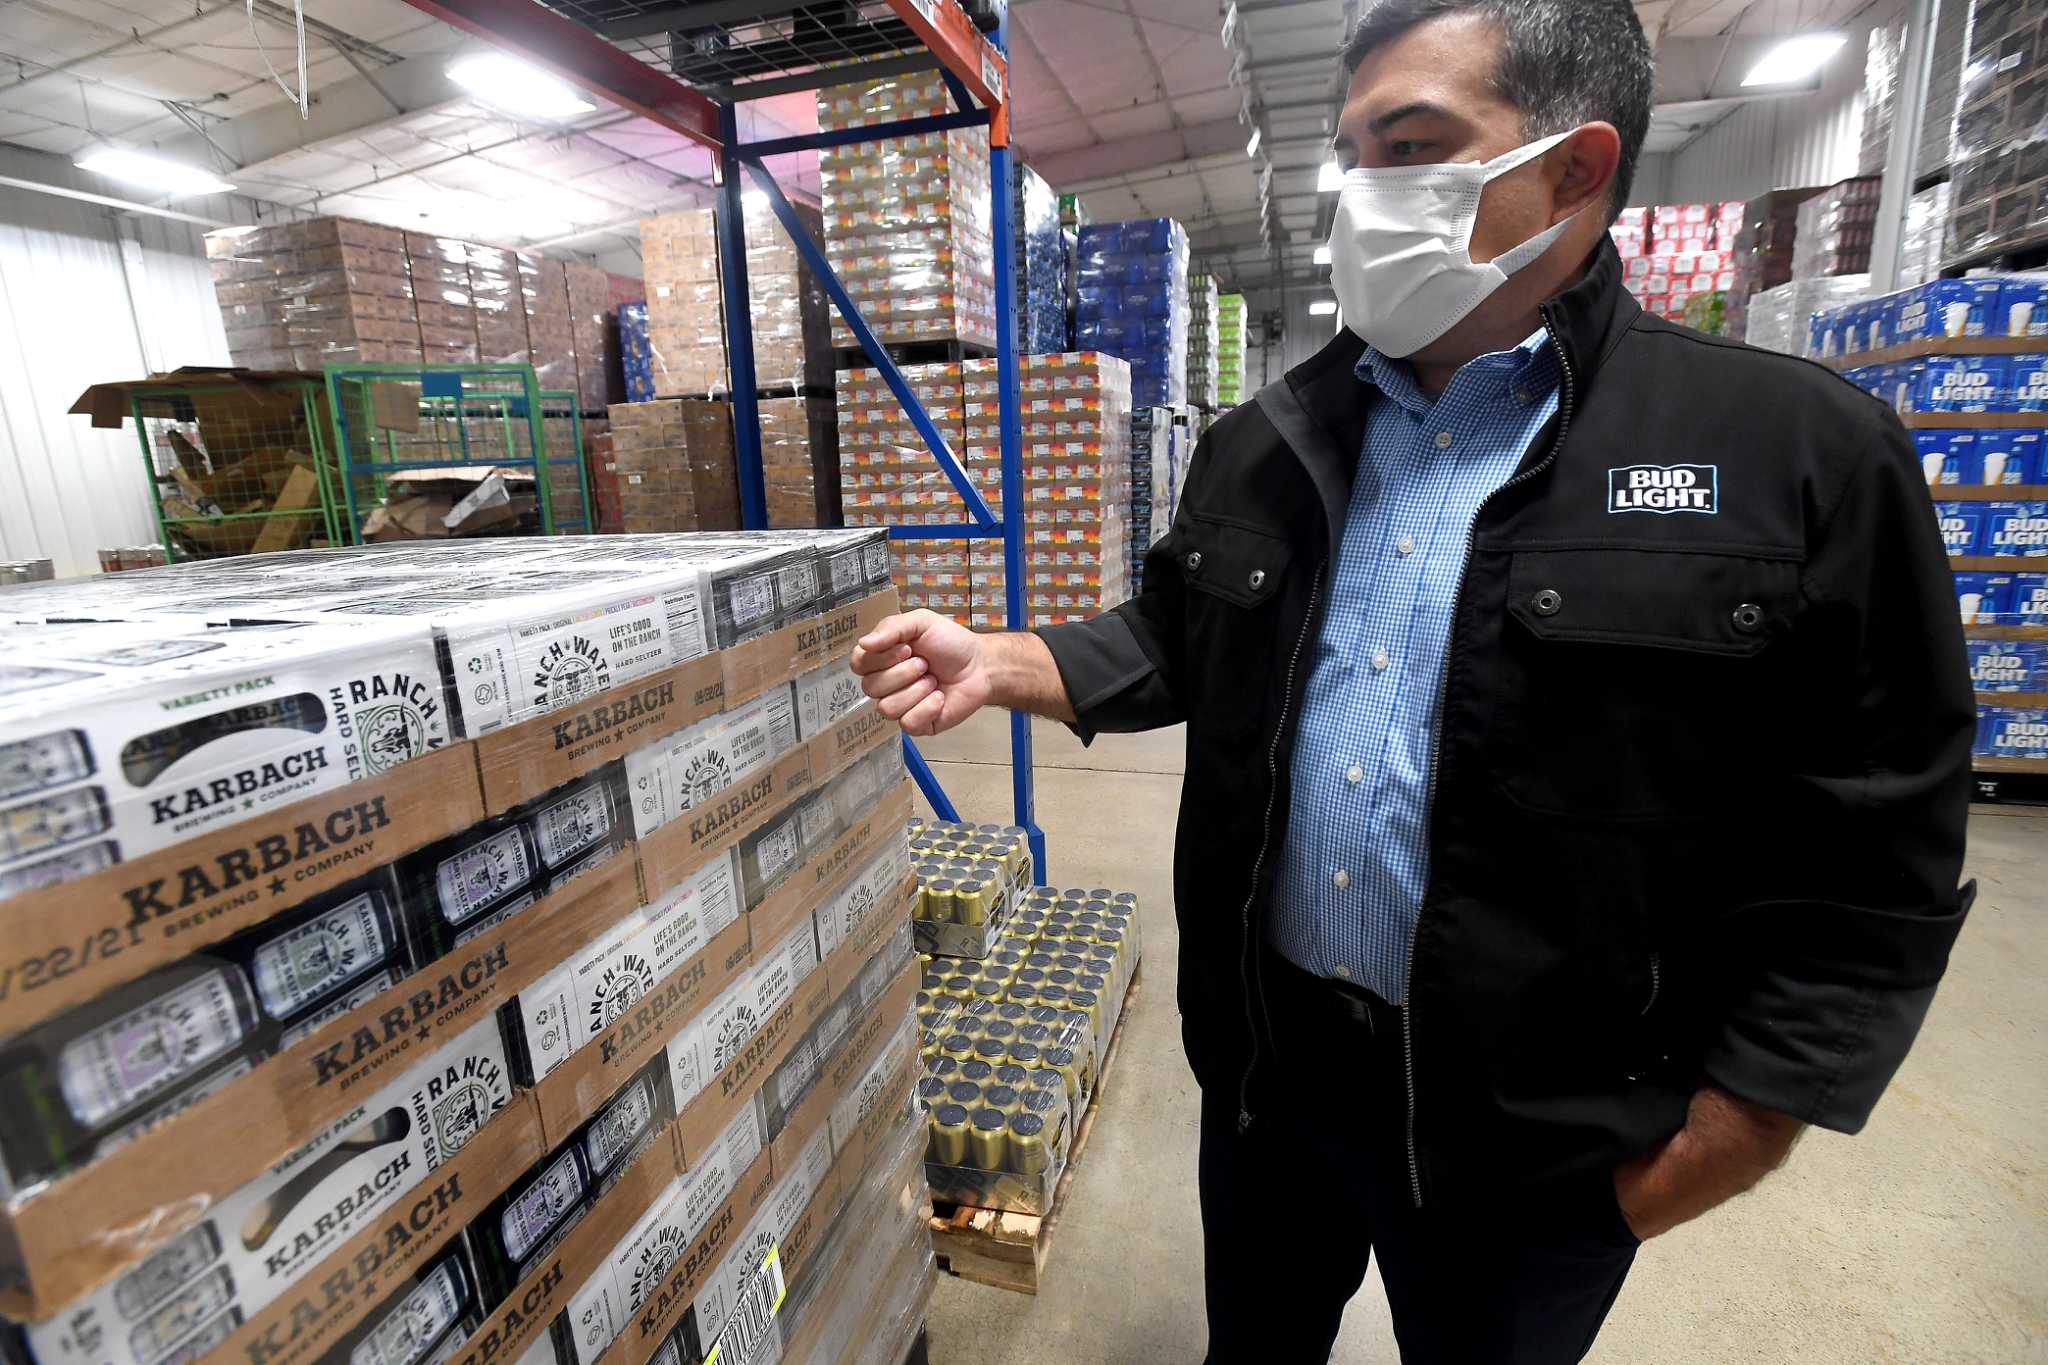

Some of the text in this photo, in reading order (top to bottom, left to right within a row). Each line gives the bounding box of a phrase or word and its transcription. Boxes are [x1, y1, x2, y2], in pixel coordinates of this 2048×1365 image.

[1932, 386, 1996, 401] LIGHT
[1942, 372, 1989, 387] BUD
[2017, 386, 2048, 401] LIG
[1615, 488, 1711, 509] LIGHT
[1629, 469, 1697, 489] BUD
[1938, 518, 1966, 532] UD
[2004, 518, 2048, 532] BUD
[2019, 601, 2048, 616] LIG
[609, 622, 632, 640] LIFE'S
[612, 641, 623, 653] ON
[624, 635, 639, 650] THE
[534, 641, 564, 705] ANCH
[573, 635, 611, 691] WATE
[615, 648, 662, 670] HARD SELTZER
[1969, 668, 2028, 682] LIGHT
[1976, 655, 2022, 669] BUD
[235, 675, 275, 695] PACK
[349, 673, 437, 720] RANCH
[329, 687, 353, 738] HARD
[552, 680, 675, 750] KARBACH
[2005, 722, 2048, 737] BUD
[568, 711, 666, 762] BREWING COMPANY
[151, 746, 328, 825] KARBACH
[259, 777, 318, 802] COMPANY
[681, 756, 702, 810] ANCH
[707, 749, 732, 788] WATE
[688, 774, 773, 844] KARBACH
[122, 794, 391, 926] KARBACH
[162, 840, 376, 938] BREWING COMPANY
[653, 925, 673, 946] LIFE'S
[655, 944, 666, 957] ON
[665, 934, 679, 949] THE
[623, 953, 655, 993] WATE
[657, 955, 675, 972] HARD
[311, 941, 510, 1087] KARBACH
[590, 967, 616, 1033] ANCH
[600, 958, 707, 1065] KARBACH
[736, 1004, 758, 1036] WATE
[340, 982, 498, 1090] BREWING COMPANY
[713, 1018, 732, 1073] ANCH
[721, 1003, 794, 1097] KARBACH
[427, 1056, 500, 1101] RANCH
[333, 1106, 367, 1133] PACK
[411, 1091, 439, 1172] HARD SELT
[264, 1150, 411, 1277] KARBACH
[383, 1216, 451, 1279] COMPANY
[658, 1225, 688, 1256] WATE
[245, 1172, 463, 1365] KARBACH
[630, 1247, 652, 1313] ANCH
[640, 1206, 734, 1339] KARBACH
